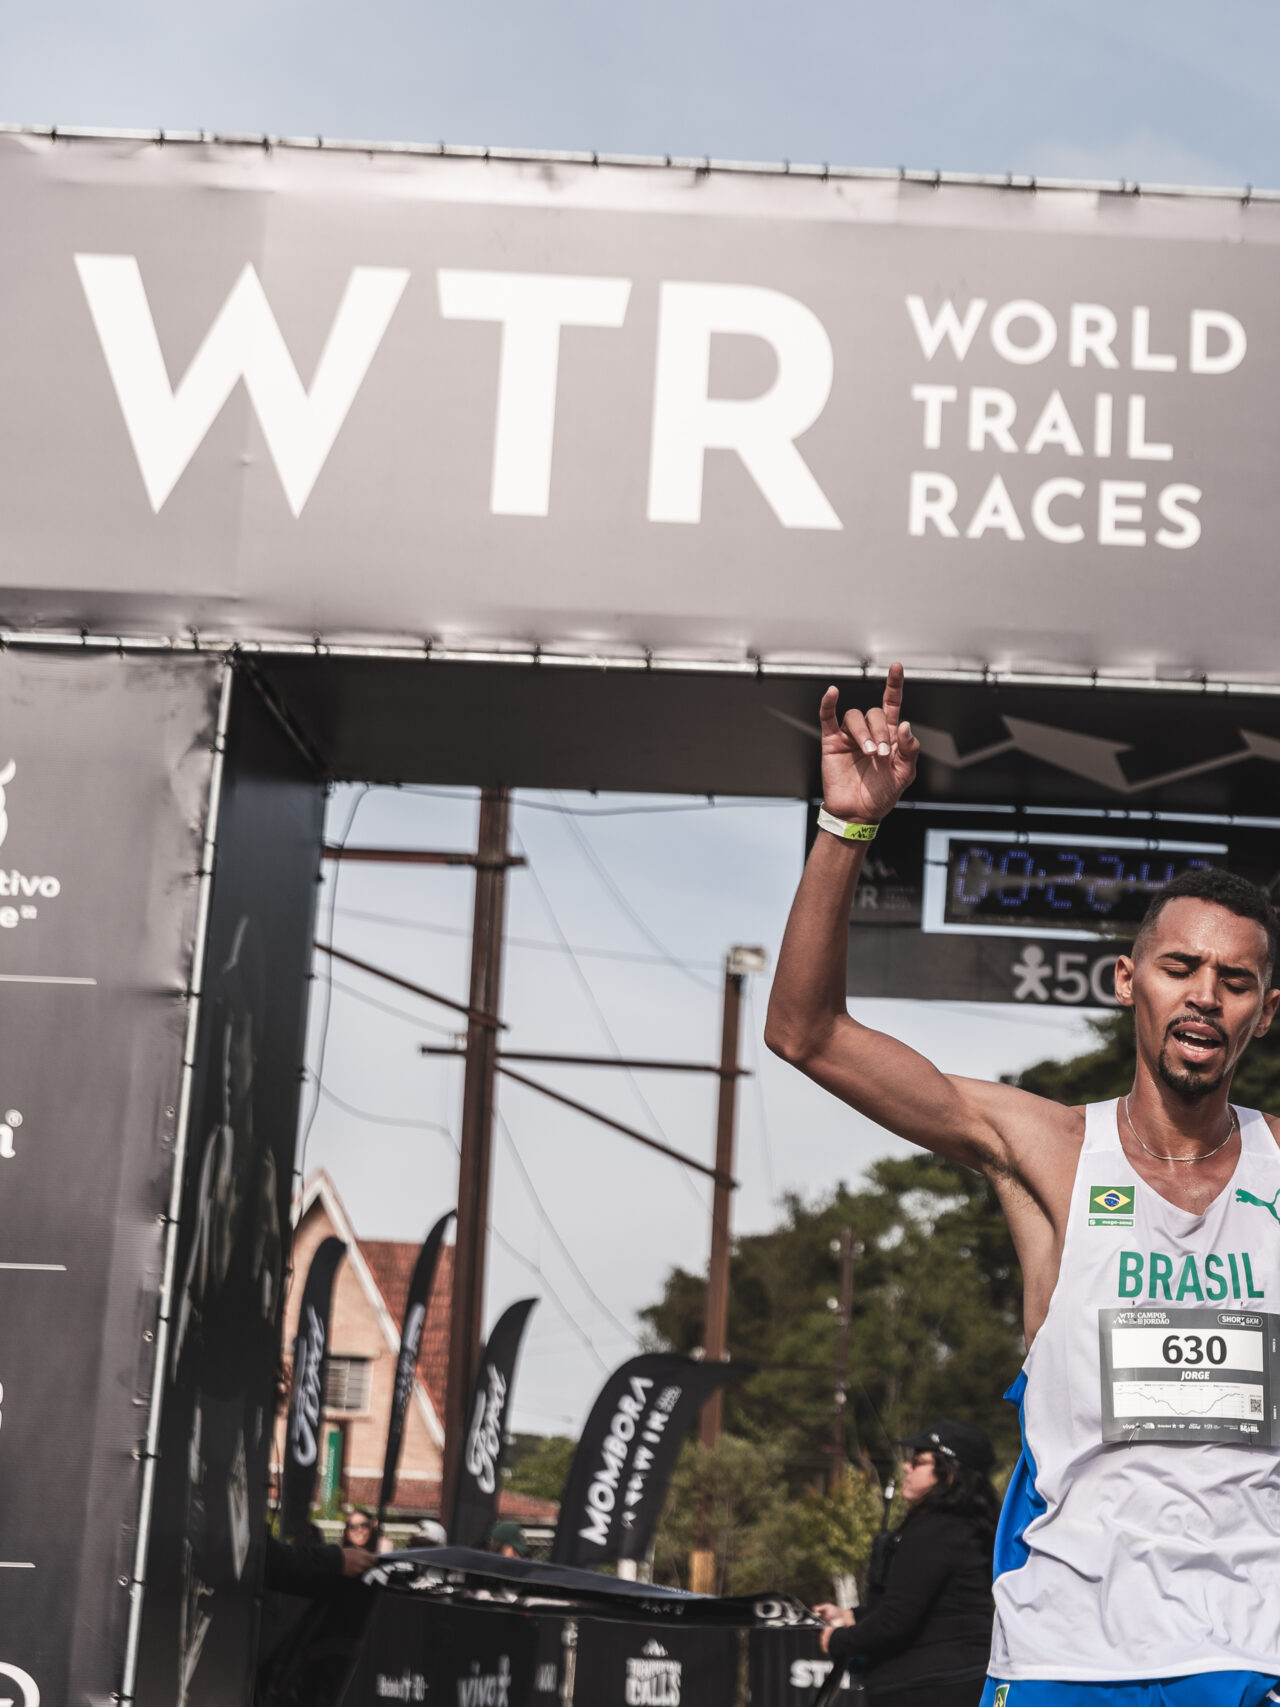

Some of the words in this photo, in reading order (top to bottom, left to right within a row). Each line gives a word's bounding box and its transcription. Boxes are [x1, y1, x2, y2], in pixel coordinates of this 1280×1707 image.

[905, 294, 1248, 374] WORLD
[72, 252, 844, 531] WTR
[911, 383, 1174, 461] TRAIL
[908, 471, 1202, 549] RACES
[954, 847, 1213, 912] 00:22:4
[1118, 1250, 1265, 1302] BRASIL
[1162, 1335, 1228, 1365] 630
[1245, 1317, 1259, 1325] 6KM
[1181, 1371, 1211, 1380] JORGE
